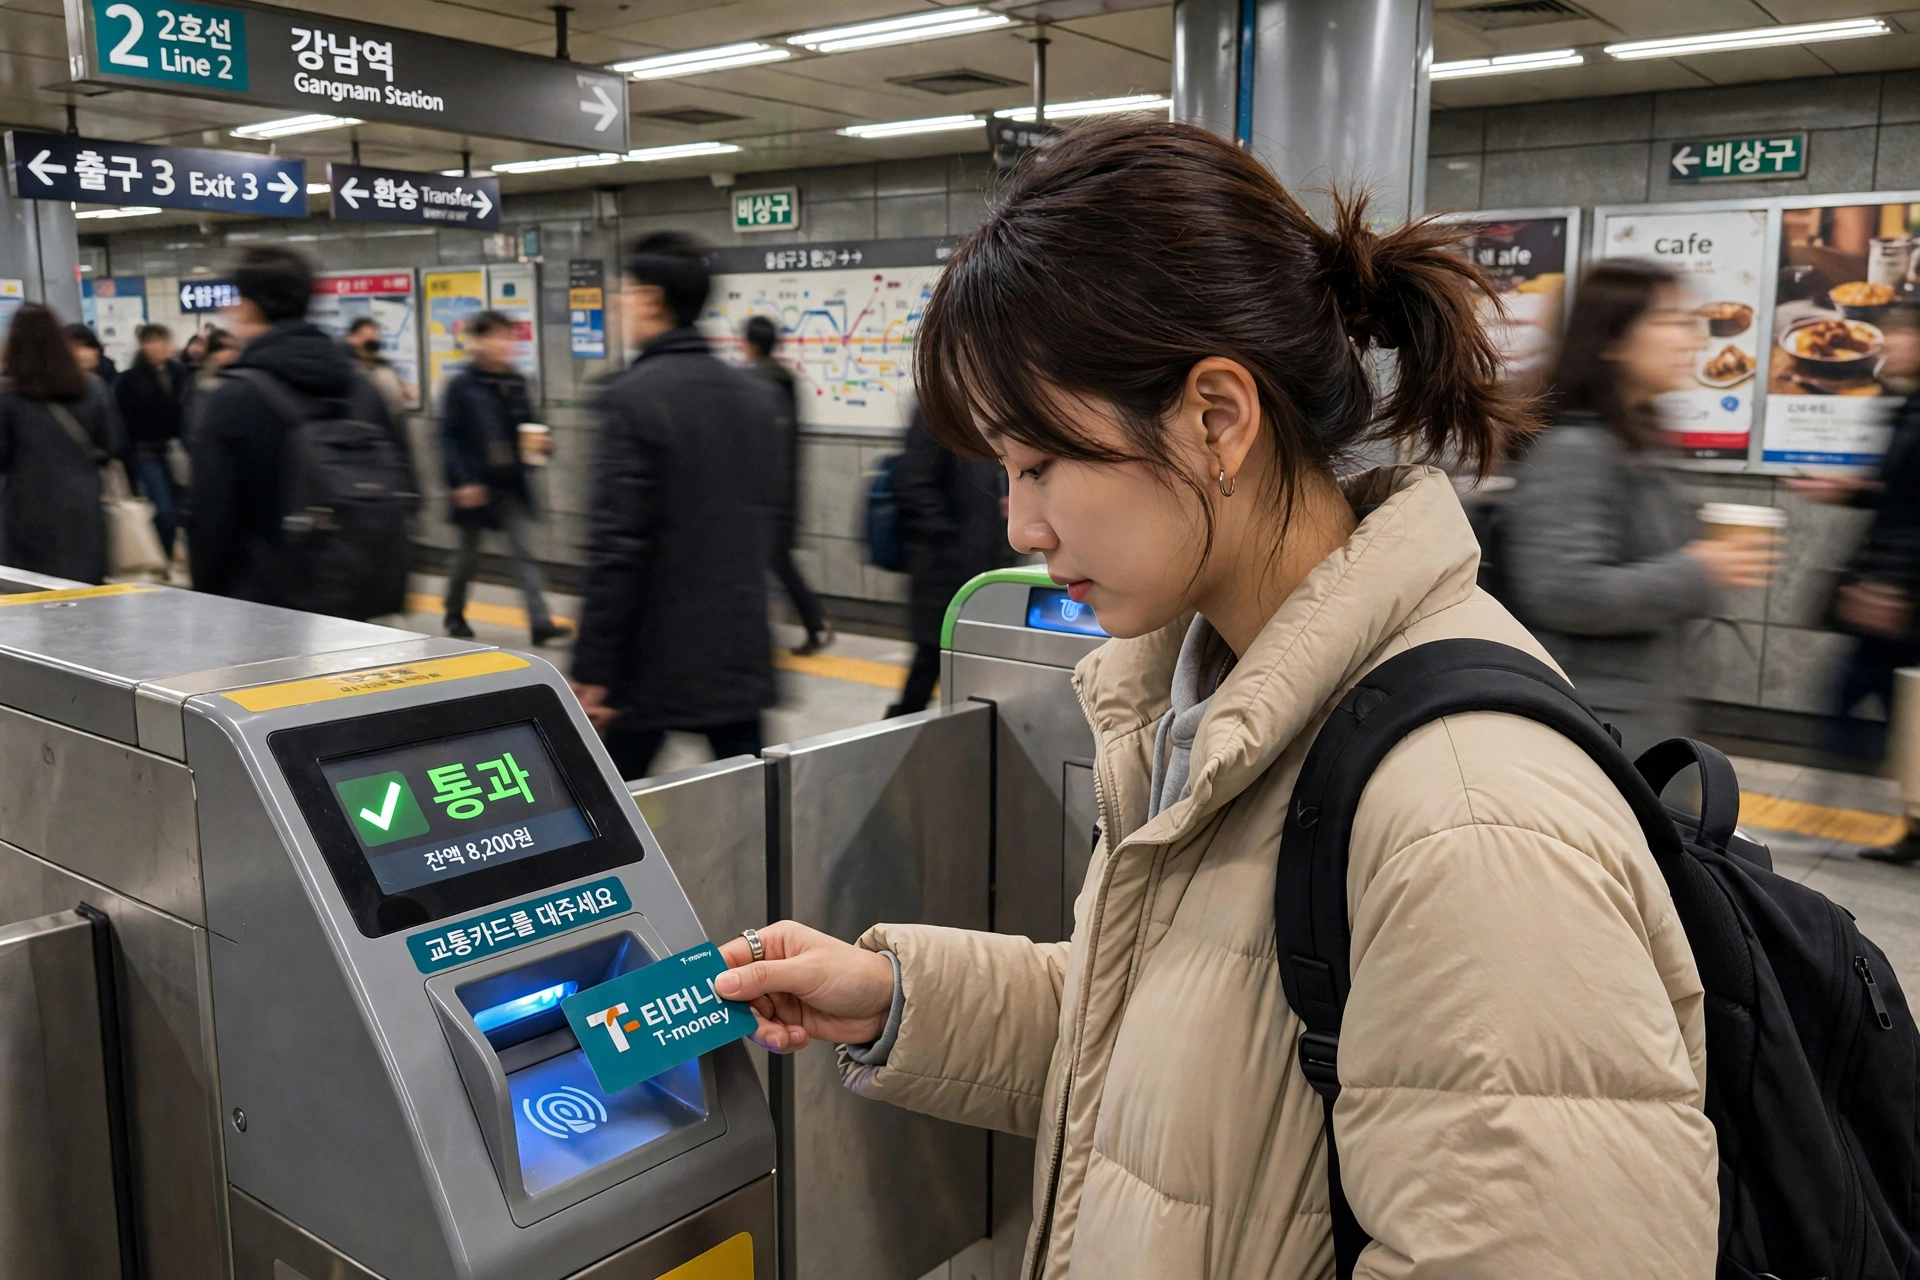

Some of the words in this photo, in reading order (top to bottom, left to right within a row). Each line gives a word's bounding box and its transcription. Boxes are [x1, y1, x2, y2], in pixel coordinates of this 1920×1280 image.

[105, 4, 149, 69] 2
[156, 9, 232, 52] 2호선
[160, 47, 211, 77] Line
[217, 55, 233, 80] 2
[290, 27, 395, 82] 강남역
[293, 72, 382, 102] Gangnam
[385, 85, 444, 112] Station
[74, 150, 143, 193] 출구
[151, 158, 176, 196] 3
[1705, 139, 1797, 174] 비상구
[189, 171, 236, 199] Exit
[241, 172, 259, 200] 3
[373, 177, 419, 211] 환승
[737, 194, 790, 225] 비상구
[1654, 232, 1713, 255] cafe
[427, 752, 535, 820] 통과
[424, 845, 466, 872] 잔액
[465, 827, 534, 862] 8,200원
[425, 910, 536, 962] 교통카드를
[535, 887, 618, 926] 대주세요
[640, 977, 723, 1026] 티머니
[652, 1007, 730, 1047] T-money
